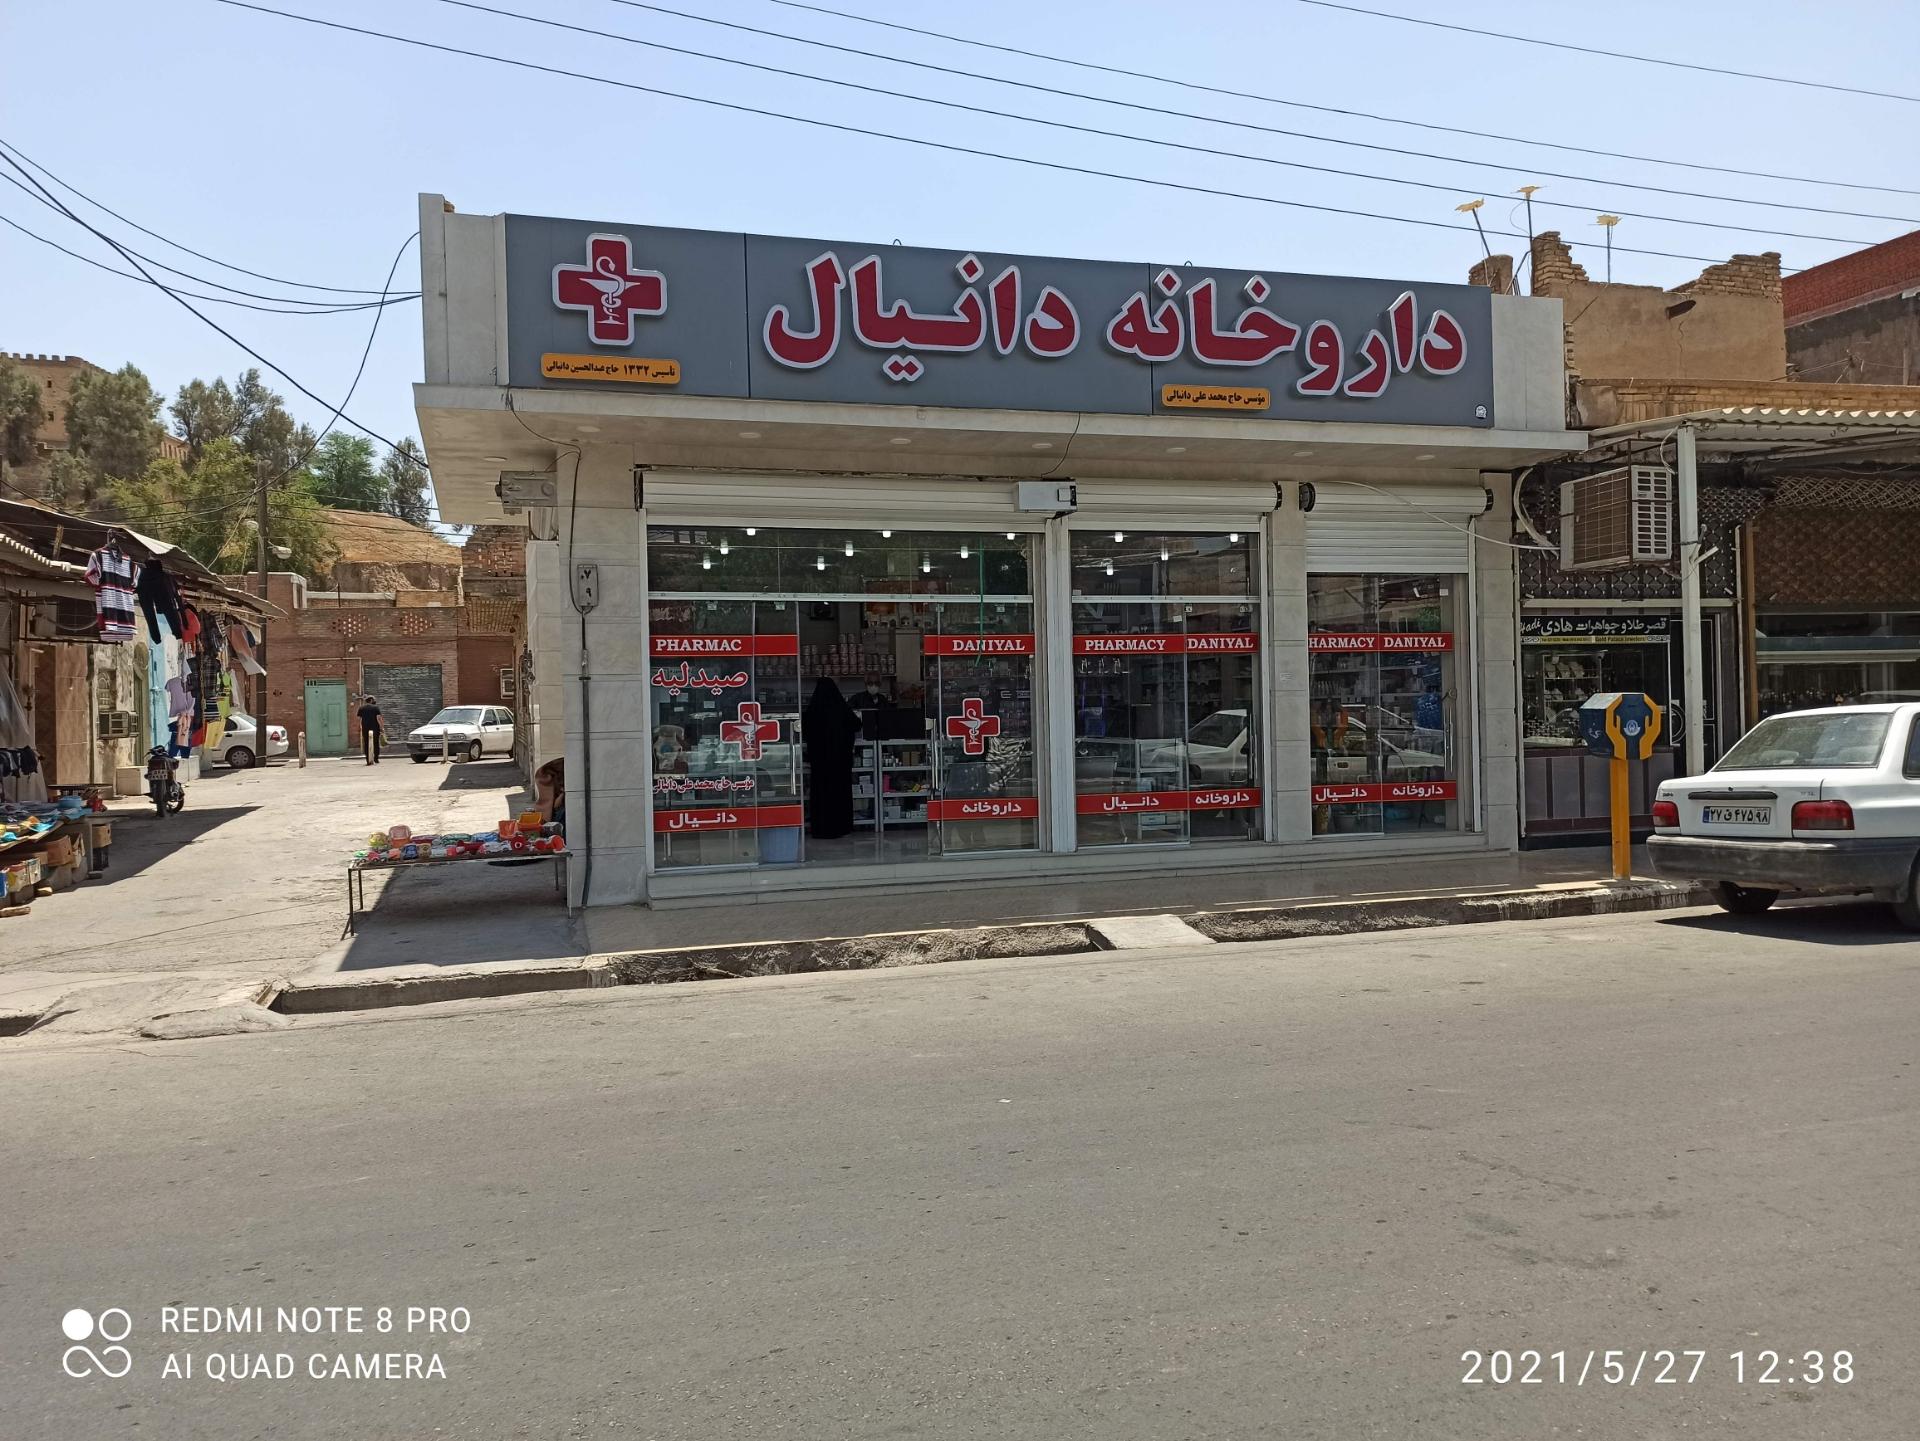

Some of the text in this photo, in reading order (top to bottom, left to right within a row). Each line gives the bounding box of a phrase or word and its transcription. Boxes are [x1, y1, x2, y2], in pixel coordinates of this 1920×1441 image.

[763, 251, 1467, 397] داروخانه دانیال
[546, 361, 569, 372] دانیالی
[606, 363, 619, 374] حاج
[623, 364, 649, 376] ۱۳۳۲
[1167, 390, 1191, 401] دانیالی
[1192, 391, 1206, 402] علی
[1228, 392, 1242, 403] حاج
[1541, 617, 1573, 636] هادی
[1576, 619, 1620, 634] جواهرات
[1627, 619, 1645, 629] طلا
[1644, 617, 1667, 634] قصر
[655, 639, 742, 652] PHARMAC
[952, 639, 1025, 651] DANIYAL
[1085, 637, 1254, 651] PHARMACY DANIYAL
[1309, 637, 1446, 649] HARMACY DANIYAL
[651, 661, 749, 696] صیدلیه
[676, 777, 693, 793] علی
[694, 779, 715, 790] محمد
[715, 776, 731, 791] حاج
[1315, 785, 1444, 801] داروخانه دانیال
[1104, 791, 1250, 810] داروخانه دانیال
[962, 801, 1022, 816] داروخانه
[669, 812, 738, 829] دانیال
